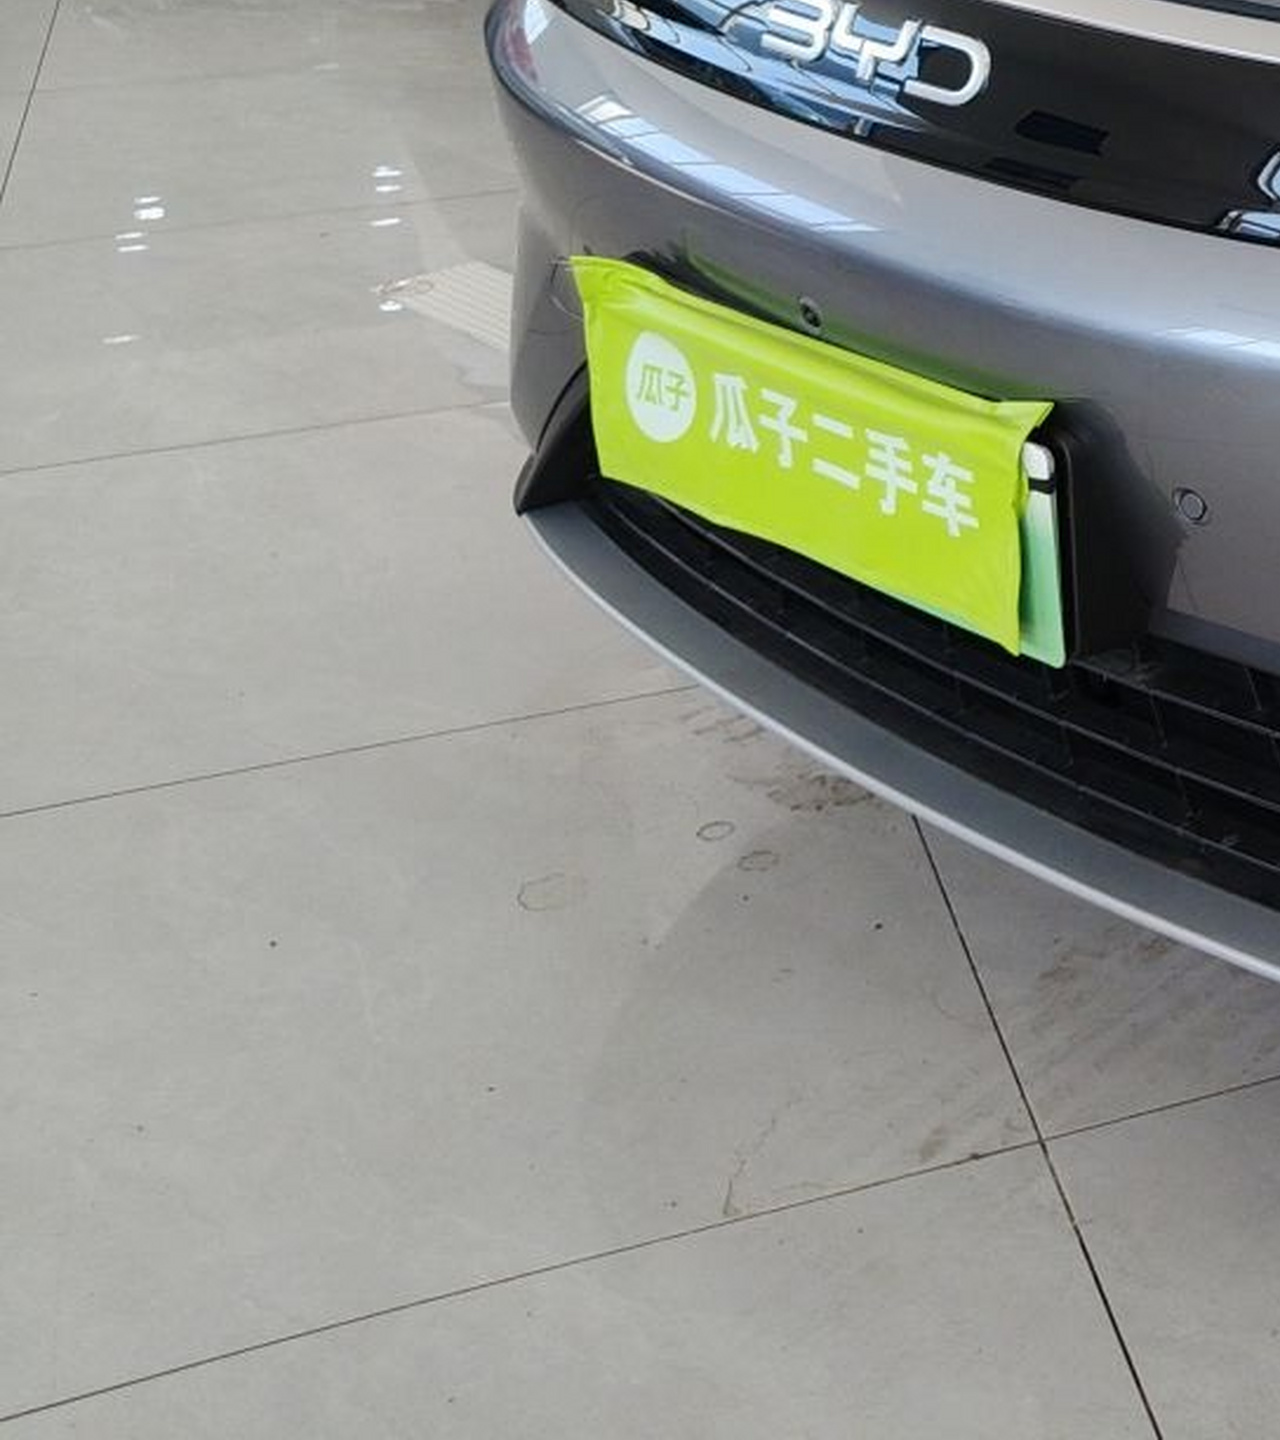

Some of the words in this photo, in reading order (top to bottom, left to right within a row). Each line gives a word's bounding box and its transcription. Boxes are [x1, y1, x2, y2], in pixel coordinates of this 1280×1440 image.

[635, 363, 690, 412] 瓜子
[710, 372, 979, 538] 瓜子二手车
